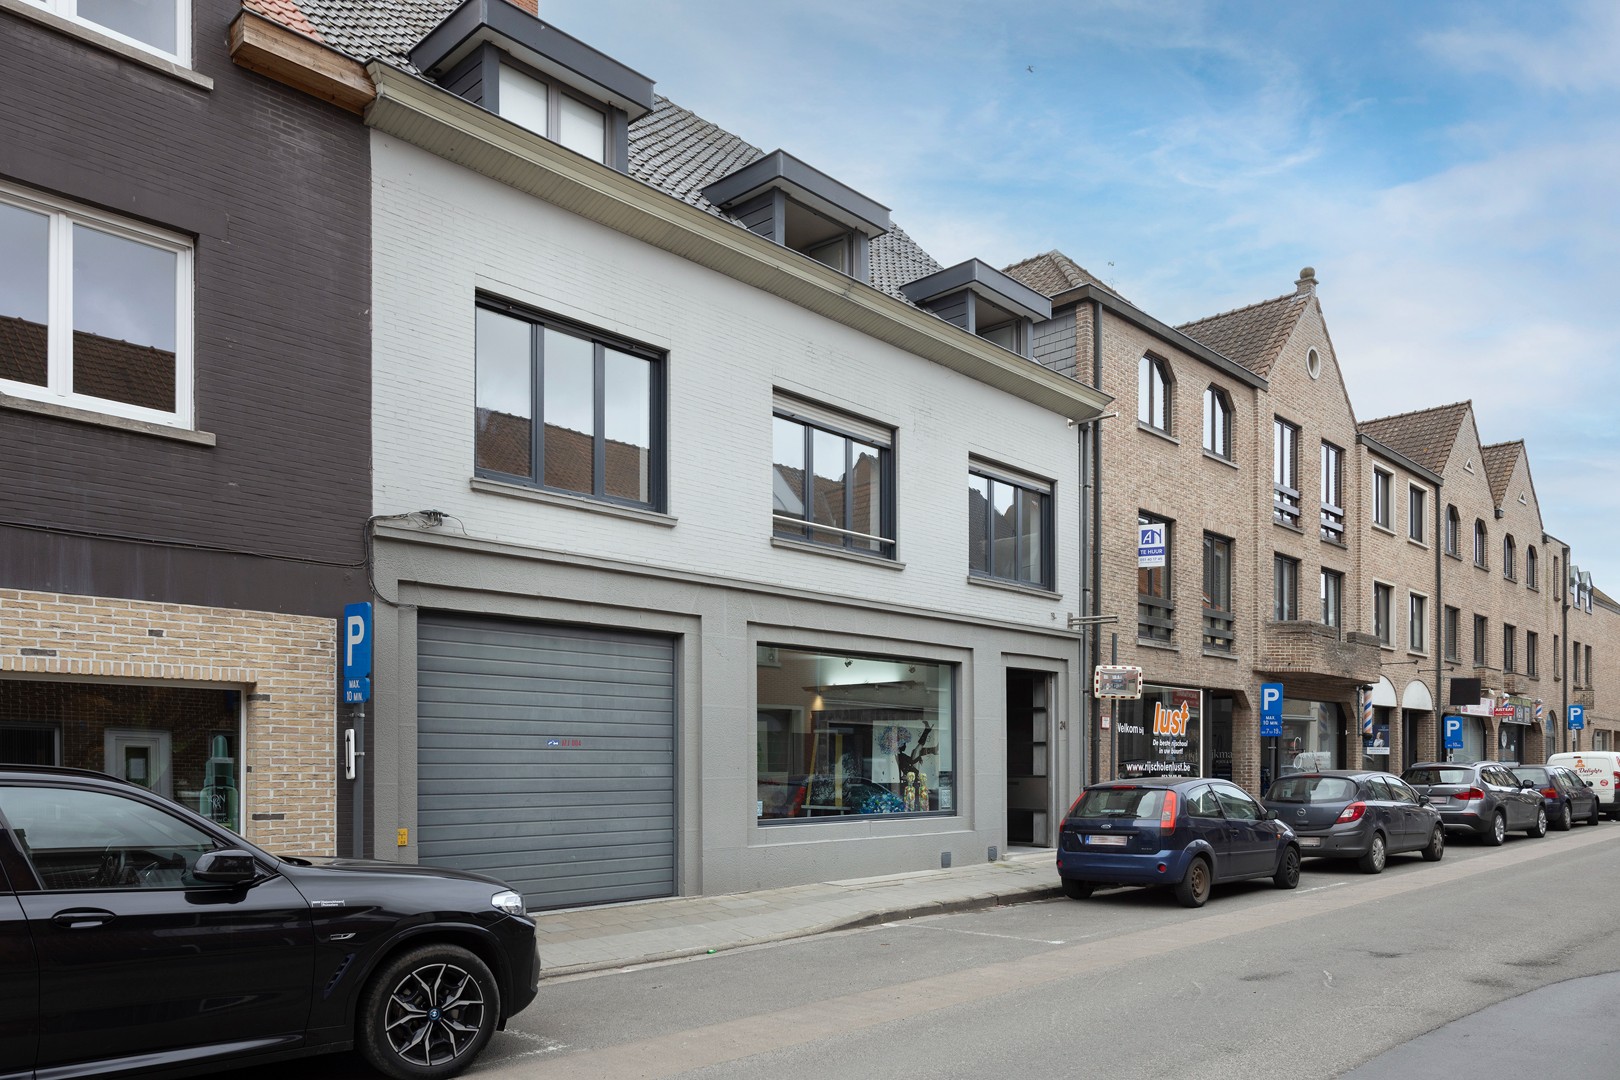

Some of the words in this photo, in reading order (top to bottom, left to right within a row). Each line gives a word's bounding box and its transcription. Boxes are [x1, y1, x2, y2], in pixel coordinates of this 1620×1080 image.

[347, 615, 365, 666] P
[349, 680, 360, 689] MAX.
[346, 691, 353, 702] 10
[353, 692, 363, 701] MIN.
[1264, 689, 1279, 710] P
[1153, 700, 1189, 735] lust
[1570, 708, 1582, 721] P
[1447, 720, 1460, 736] P
[1159, 739, 1171, 747] beste
